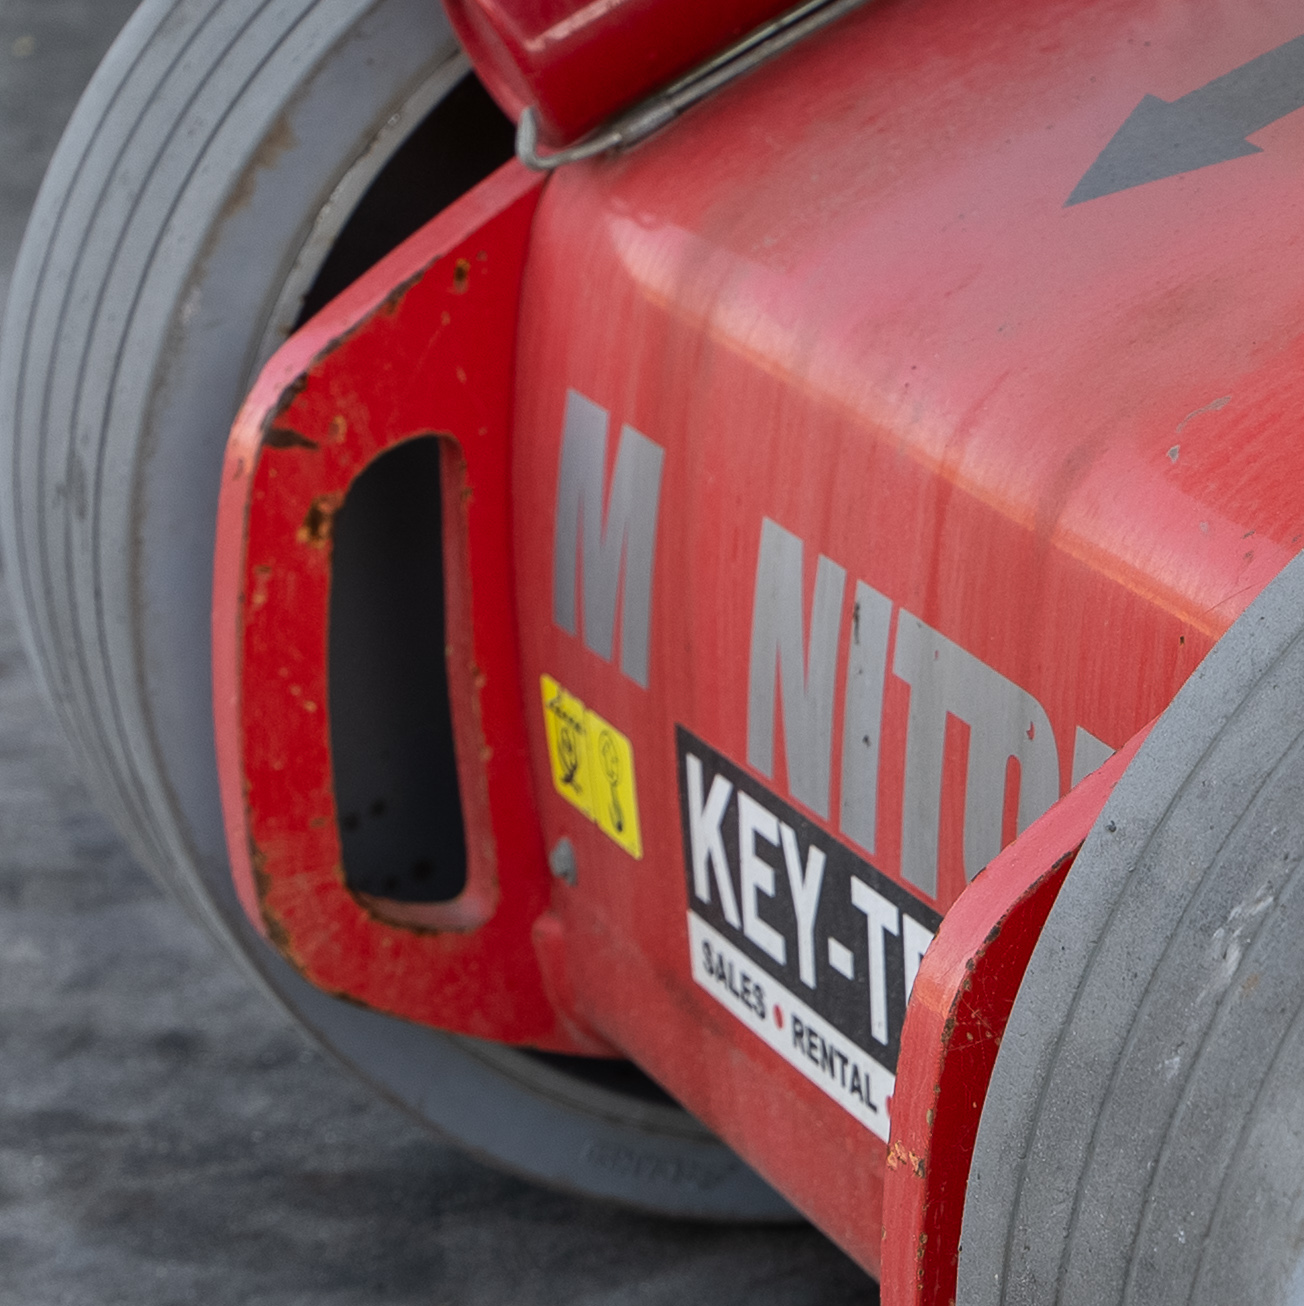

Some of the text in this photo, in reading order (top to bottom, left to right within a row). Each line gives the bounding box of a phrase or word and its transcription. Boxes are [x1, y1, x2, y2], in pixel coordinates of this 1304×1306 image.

[747, 515, 1118, 900] NITO
[701, 936, 879, 1113] SALES RENTAL
